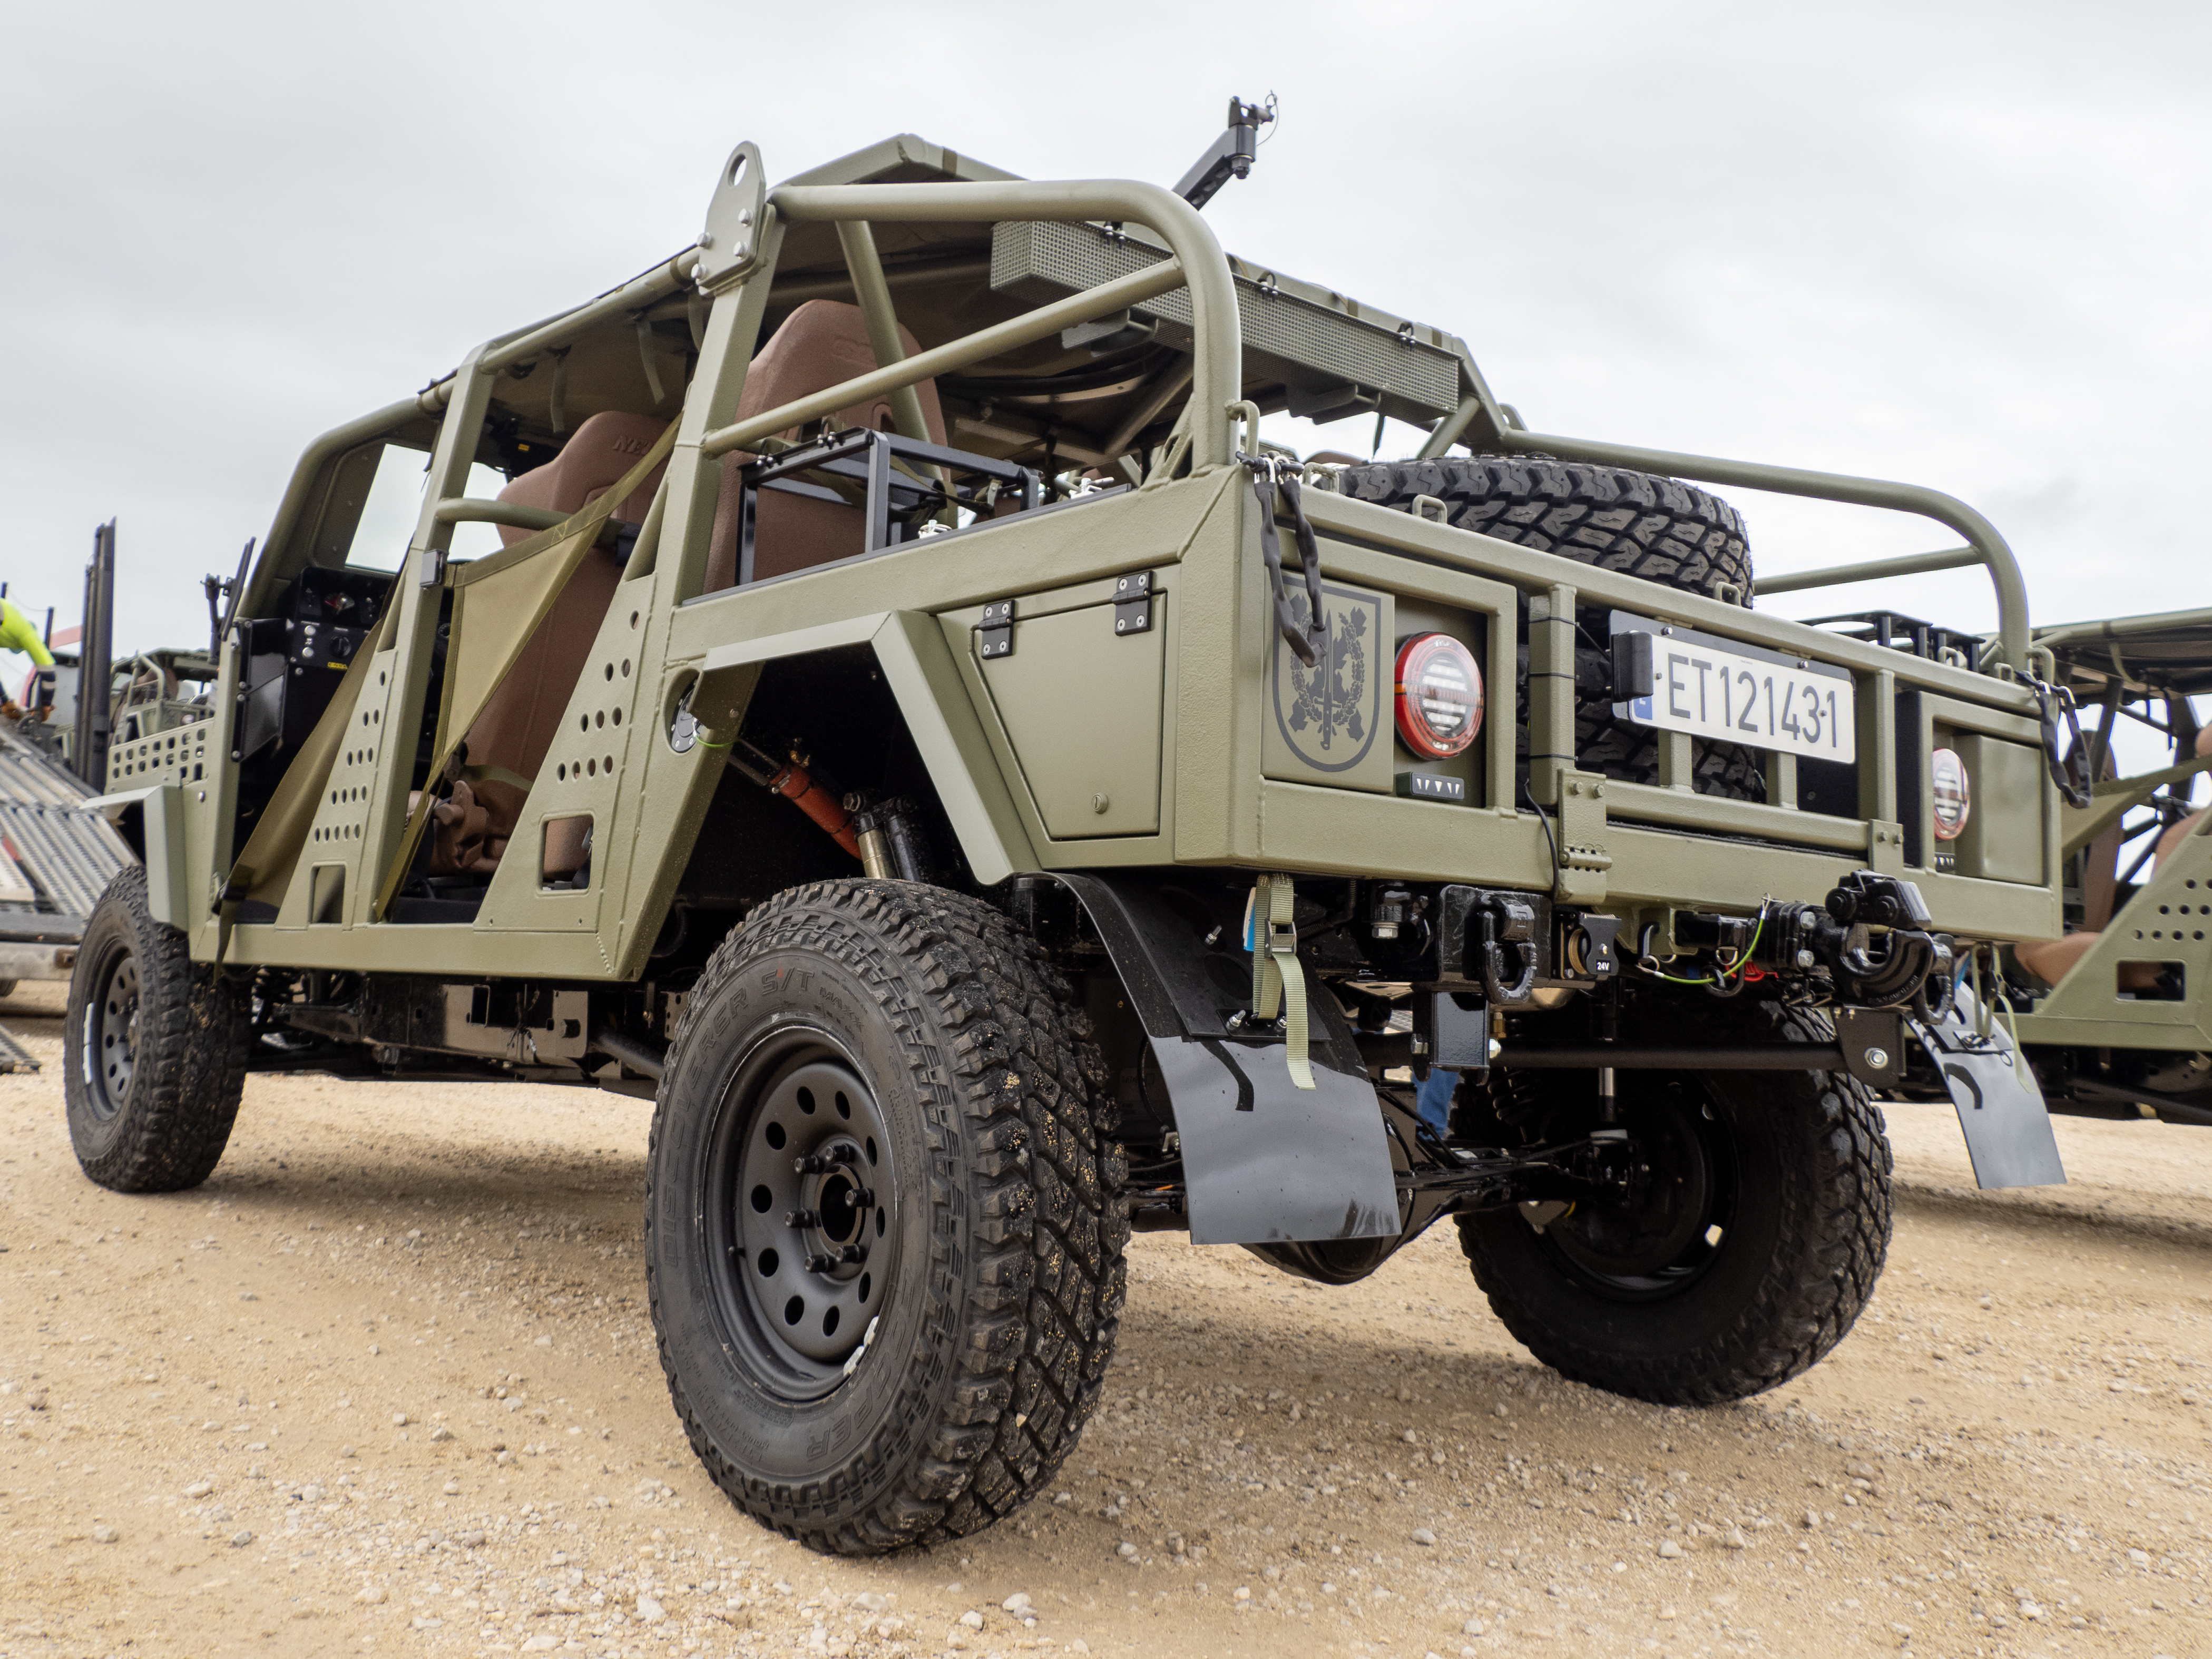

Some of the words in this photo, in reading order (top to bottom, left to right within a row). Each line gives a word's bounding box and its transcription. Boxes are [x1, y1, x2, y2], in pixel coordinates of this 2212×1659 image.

[1668, 652, 1837, 749] ET121431
[1597, 961, 1610, 970] 24V
[661, 984, 750, 1269] DISCOVERER
[761, 967, 815, 996] S/T
[819, 986, 864, 1033] MAXX
[805, 1267, 917, 1463] COOPER
